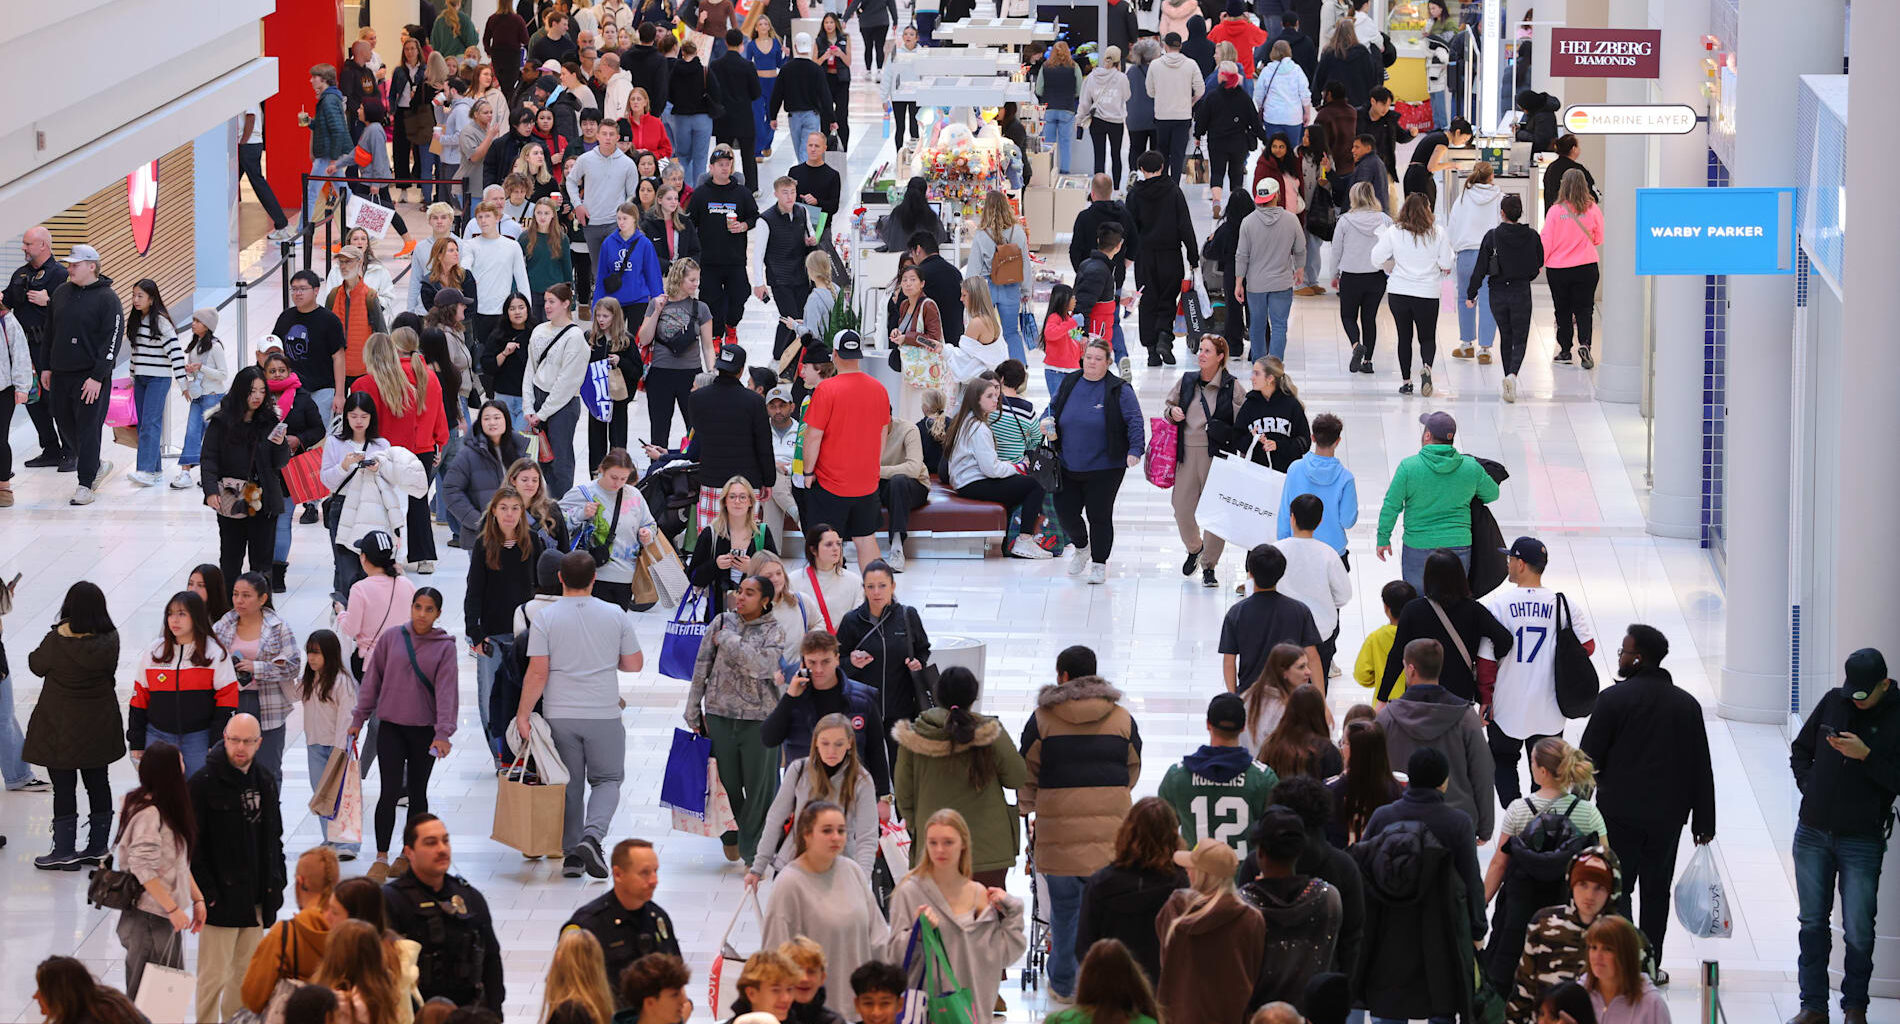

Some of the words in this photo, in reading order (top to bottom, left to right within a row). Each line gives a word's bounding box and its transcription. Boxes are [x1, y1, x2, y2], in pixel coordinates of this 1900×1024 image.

[1559, 40, 1652, 55] HELZBERG
[1574, 55, 1636, 65] DIAMONDS
[1592, 116, 1643, 125] MARINE
[1648, 116, 1688, 125] LAYER
[1650, 226, 1702, 237] WARBY
[1707, 226, 1764, 237] PARKER
[1219, 493, 1232, 503] THE
[1231, 498, 1254, 510] SUPER
[1254, 506, 1273, 517] PUFF
[1509, 602, 1553, 619] OHTANI
[1515, 626, 1547, 663] 17
[1190, 796, 1250, 861] 12
